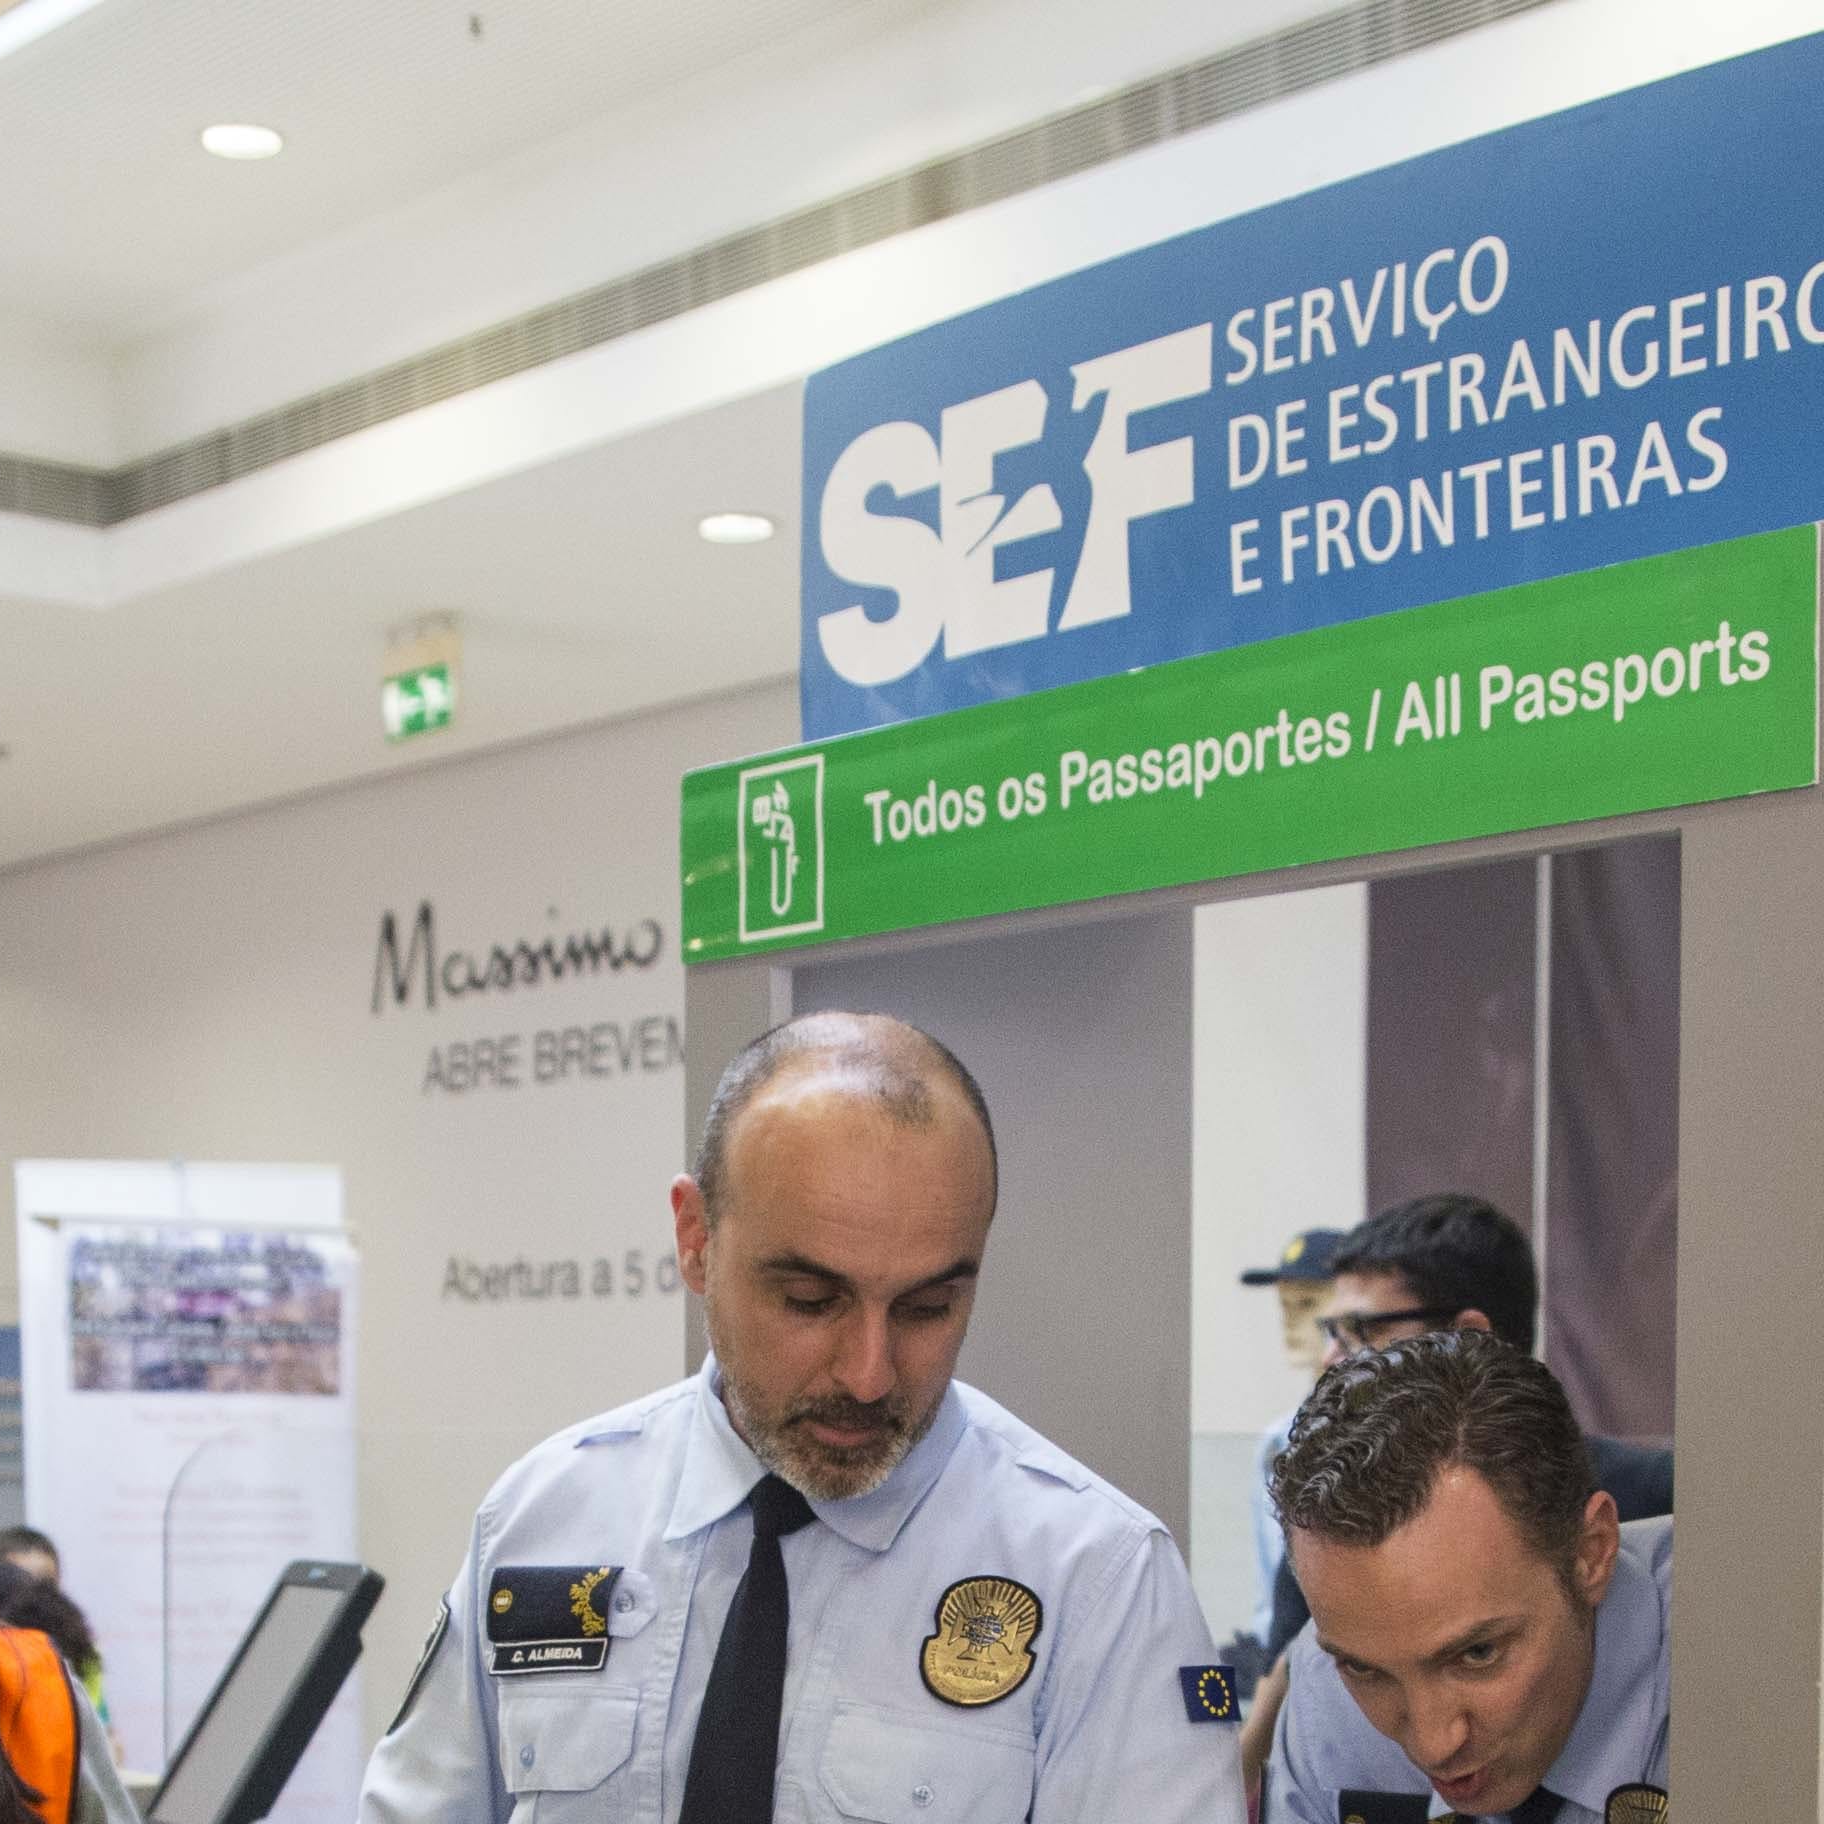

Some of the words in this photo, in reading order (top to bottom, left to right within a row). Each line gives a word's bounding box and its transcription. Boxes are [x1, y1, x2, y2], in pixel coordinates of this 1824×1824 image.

[1225, 235, 1511, 386] SERVIÇO
[1228, 397, 1310, 491] DE
[1230, 520, 1264, 597] E
[1280, 406, 1731, 588] FRONTEIRAS
[817, 321, 1213, 688] SEF
[863, 758, 988, 846] Todos
[996, 772, 1048, 821] os
[1058, 710, 1353, 810] Passaportes
[1364, 686, 1381, 752] /
[1394, 673, 1464, 745] All
[1479, 620, 1773, 732] Passports
[372, 898, 664, 1016] Massimo
[422, 1034, 522, 1093] ABRE
[442, 1254, 581, 1303] Abertura
[592, 1257, 614, 1297] a
[624, 1249, 646, 1297] 5
[511, 1650, 525, 1664] C.
[528, 1646, 583, 1661] ALMEIDA
